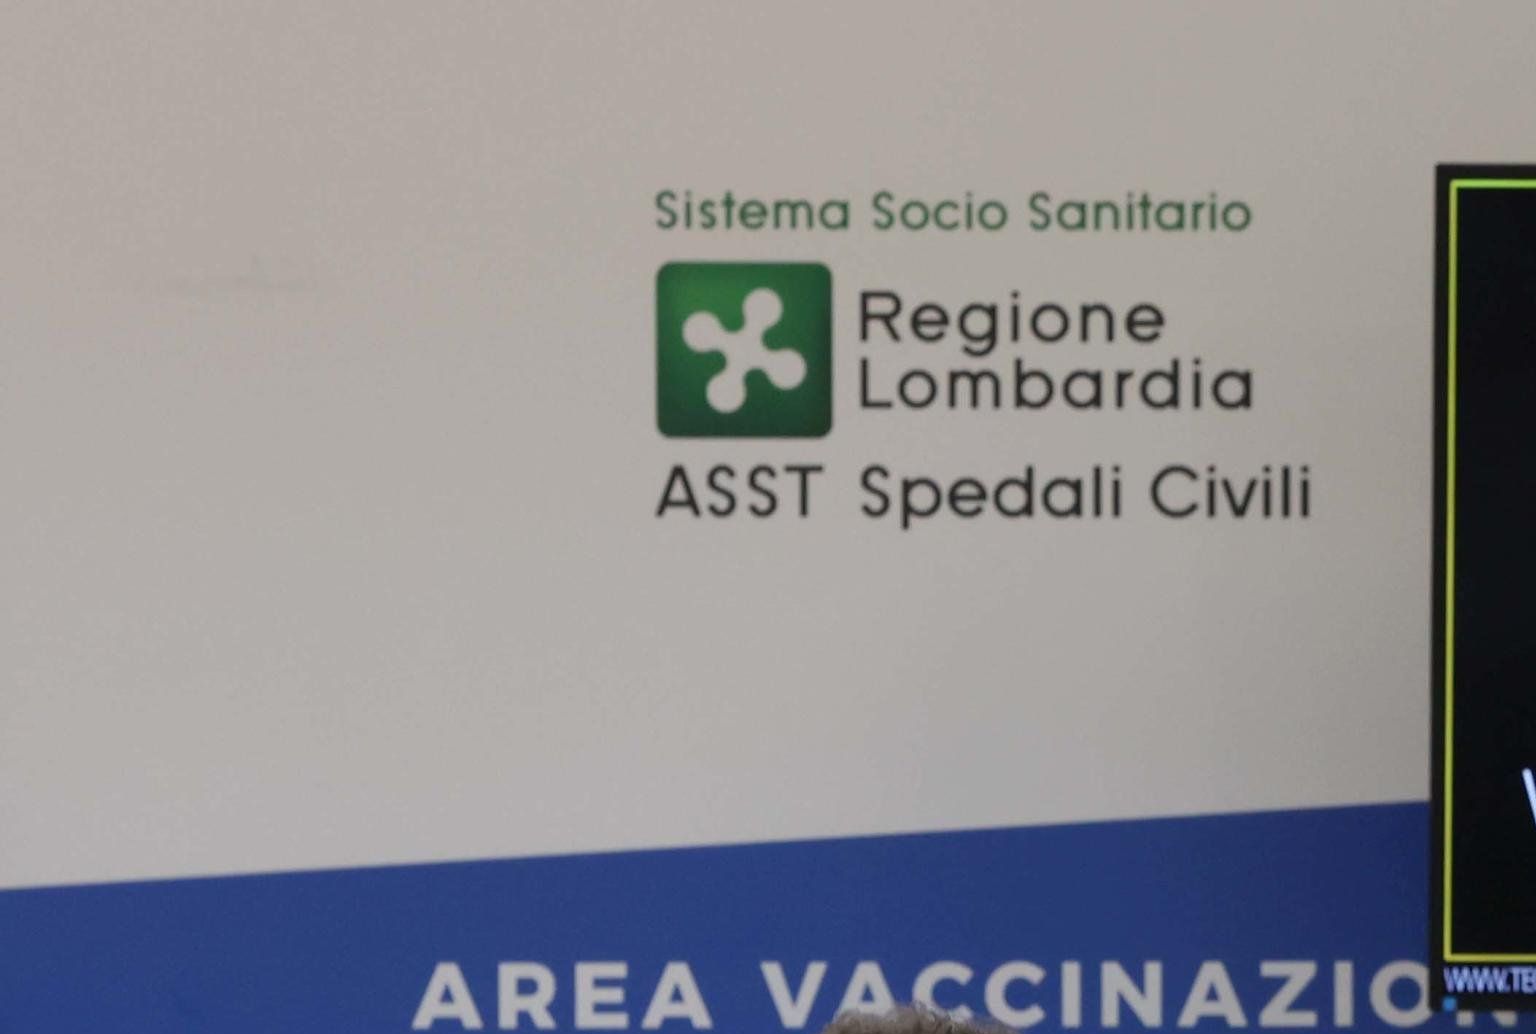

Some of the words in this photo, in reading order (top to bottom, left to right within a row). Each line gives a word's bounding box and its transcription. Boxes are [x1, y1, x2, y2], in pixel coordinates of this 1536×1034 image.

[654, 188, 852, 232] Sistema
[870, 189, 1010, 233] Socio
[1027, 190, 1254, 234] Sanitario
[858, 289, 1167, 357] Regione
[859, 356, 1255, 412] Lombardia
[654, 462, 825, 520] ASST
[859, 463, 1123, 532] Spedali
[1149, 463, 1312, 520] Civili
[411, 960, 714, 1031] AREA
